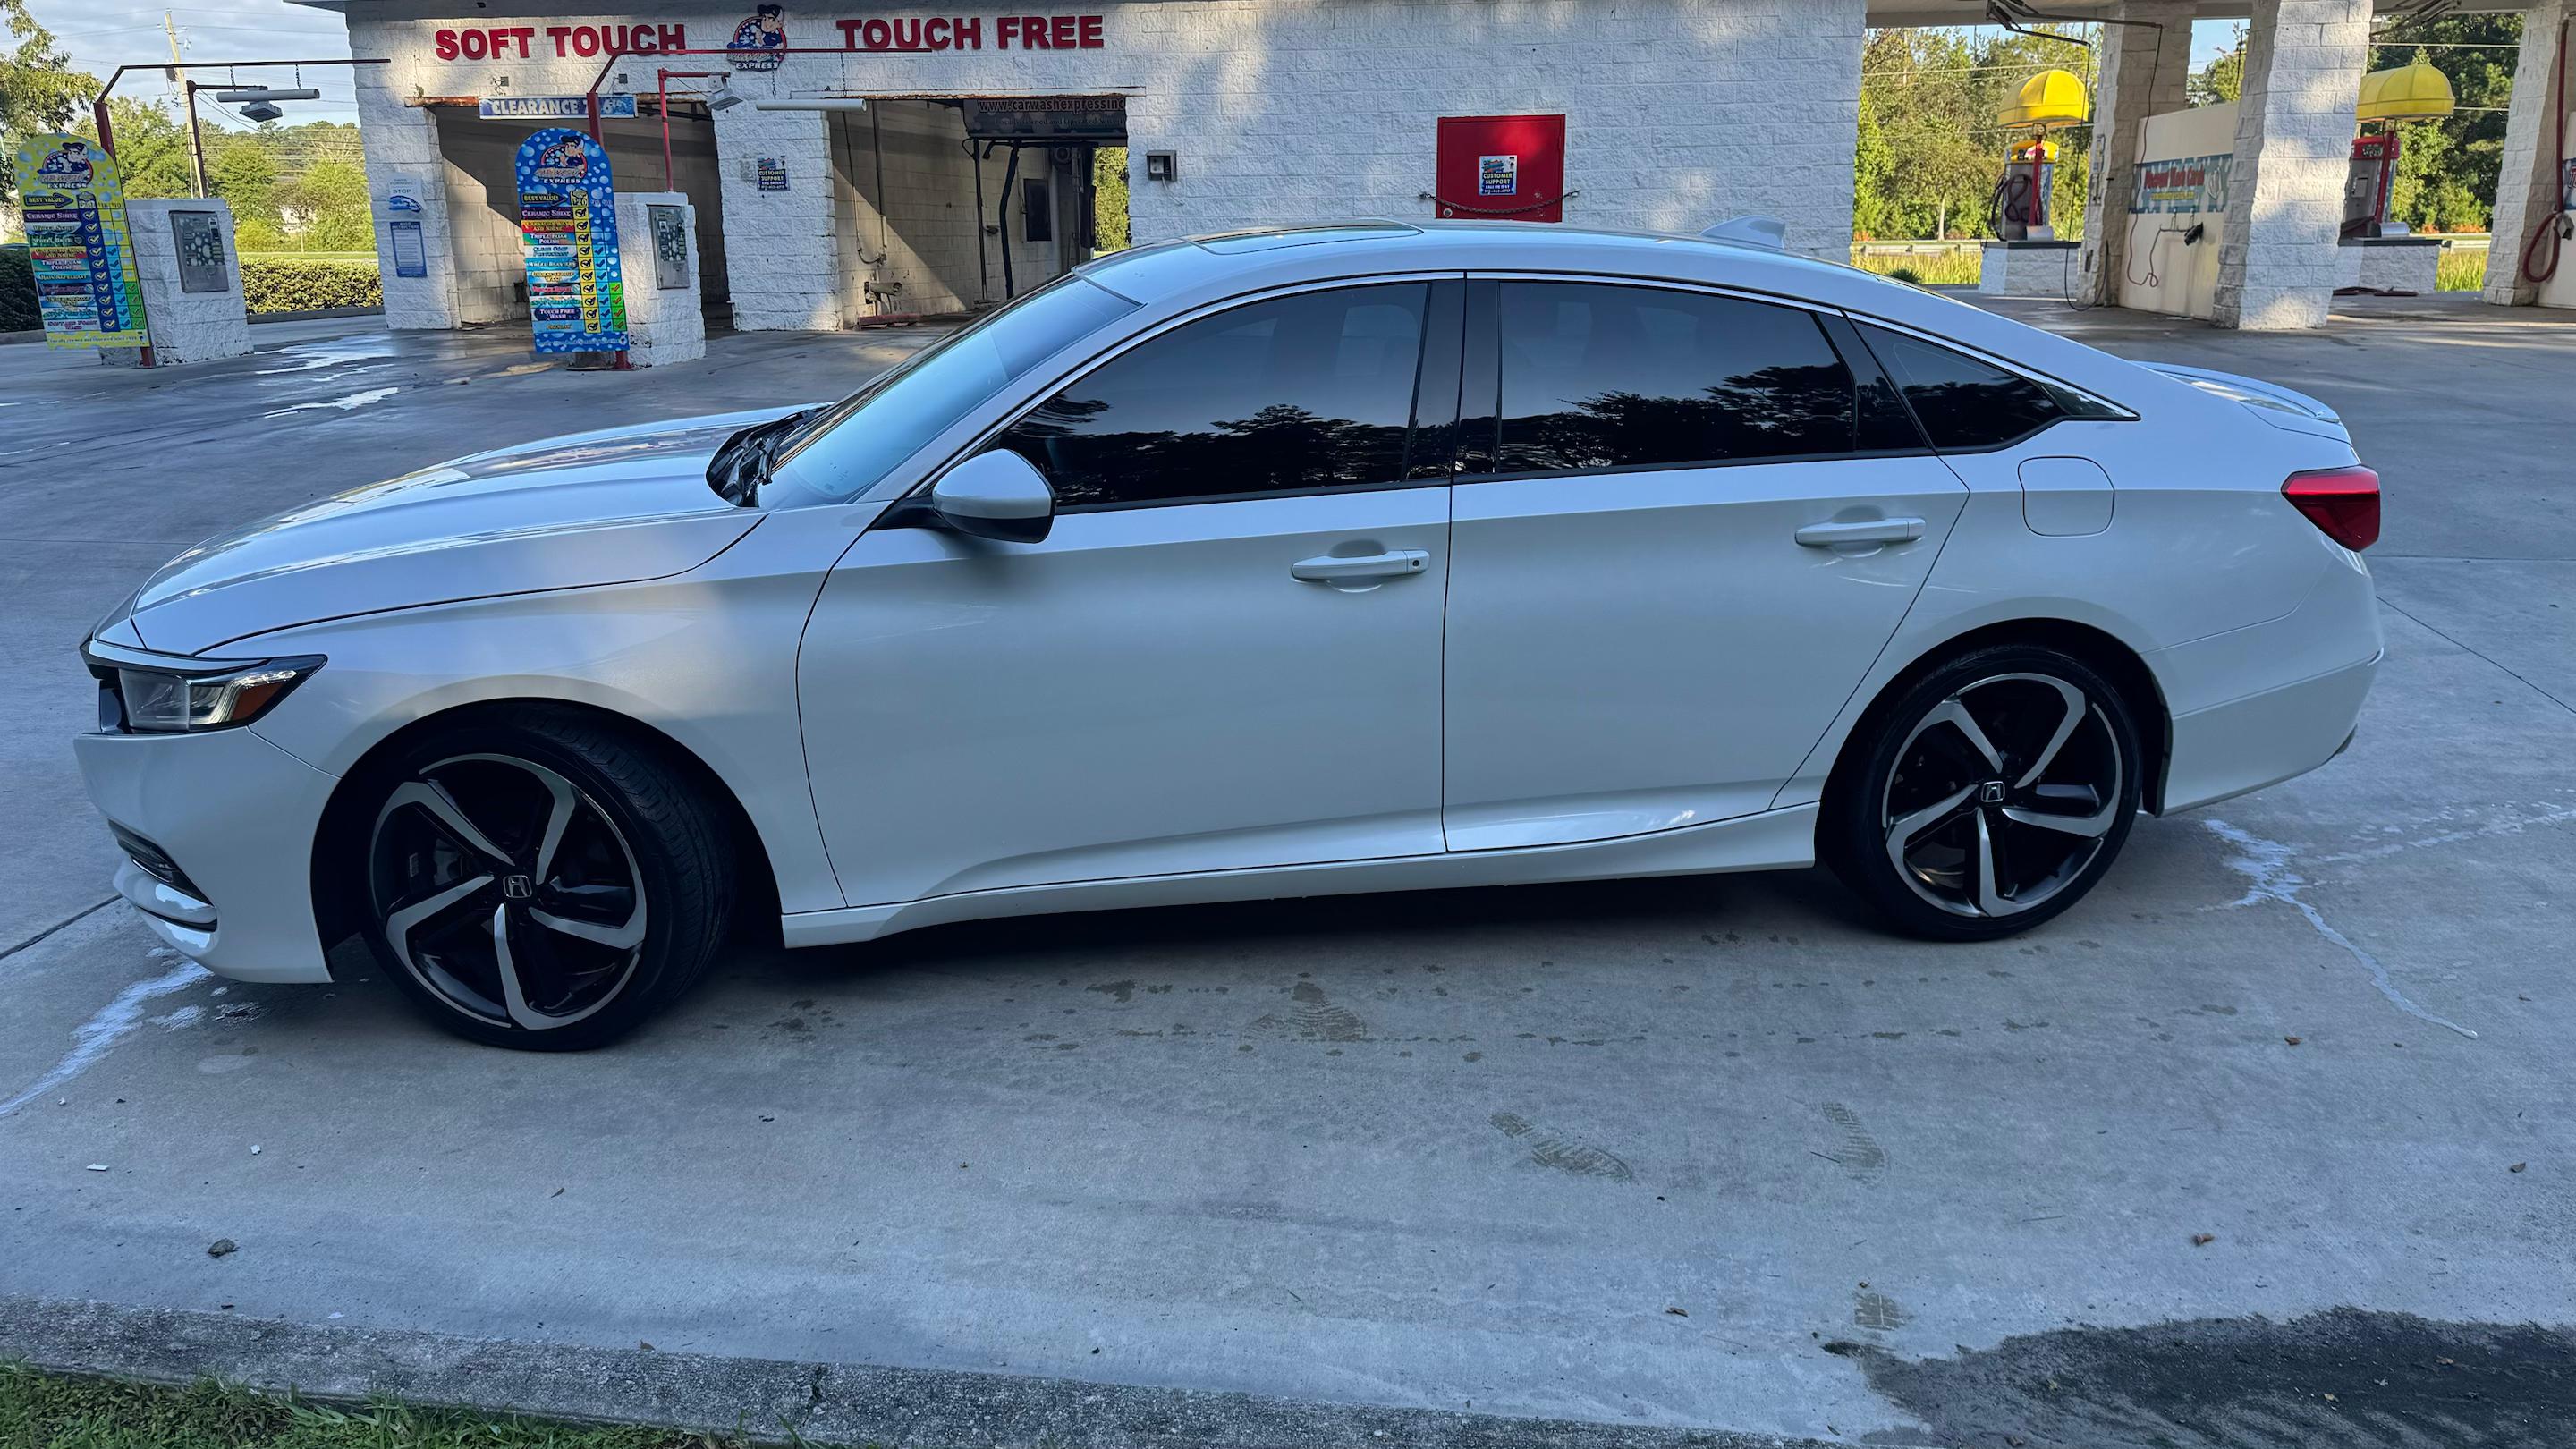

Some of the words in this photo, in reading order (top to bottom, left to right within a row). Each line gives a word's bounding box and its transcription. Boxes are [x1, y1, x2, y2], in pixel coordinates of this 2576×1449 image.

[435, 27, 535, 61] SOFT
[546, 23, 687, 57] TOUCH
[835, 16, 982, 51] TOUCH
[996, 15, 1105, 50] FREE
[492, 99, 579, 115] CLEARANCE
